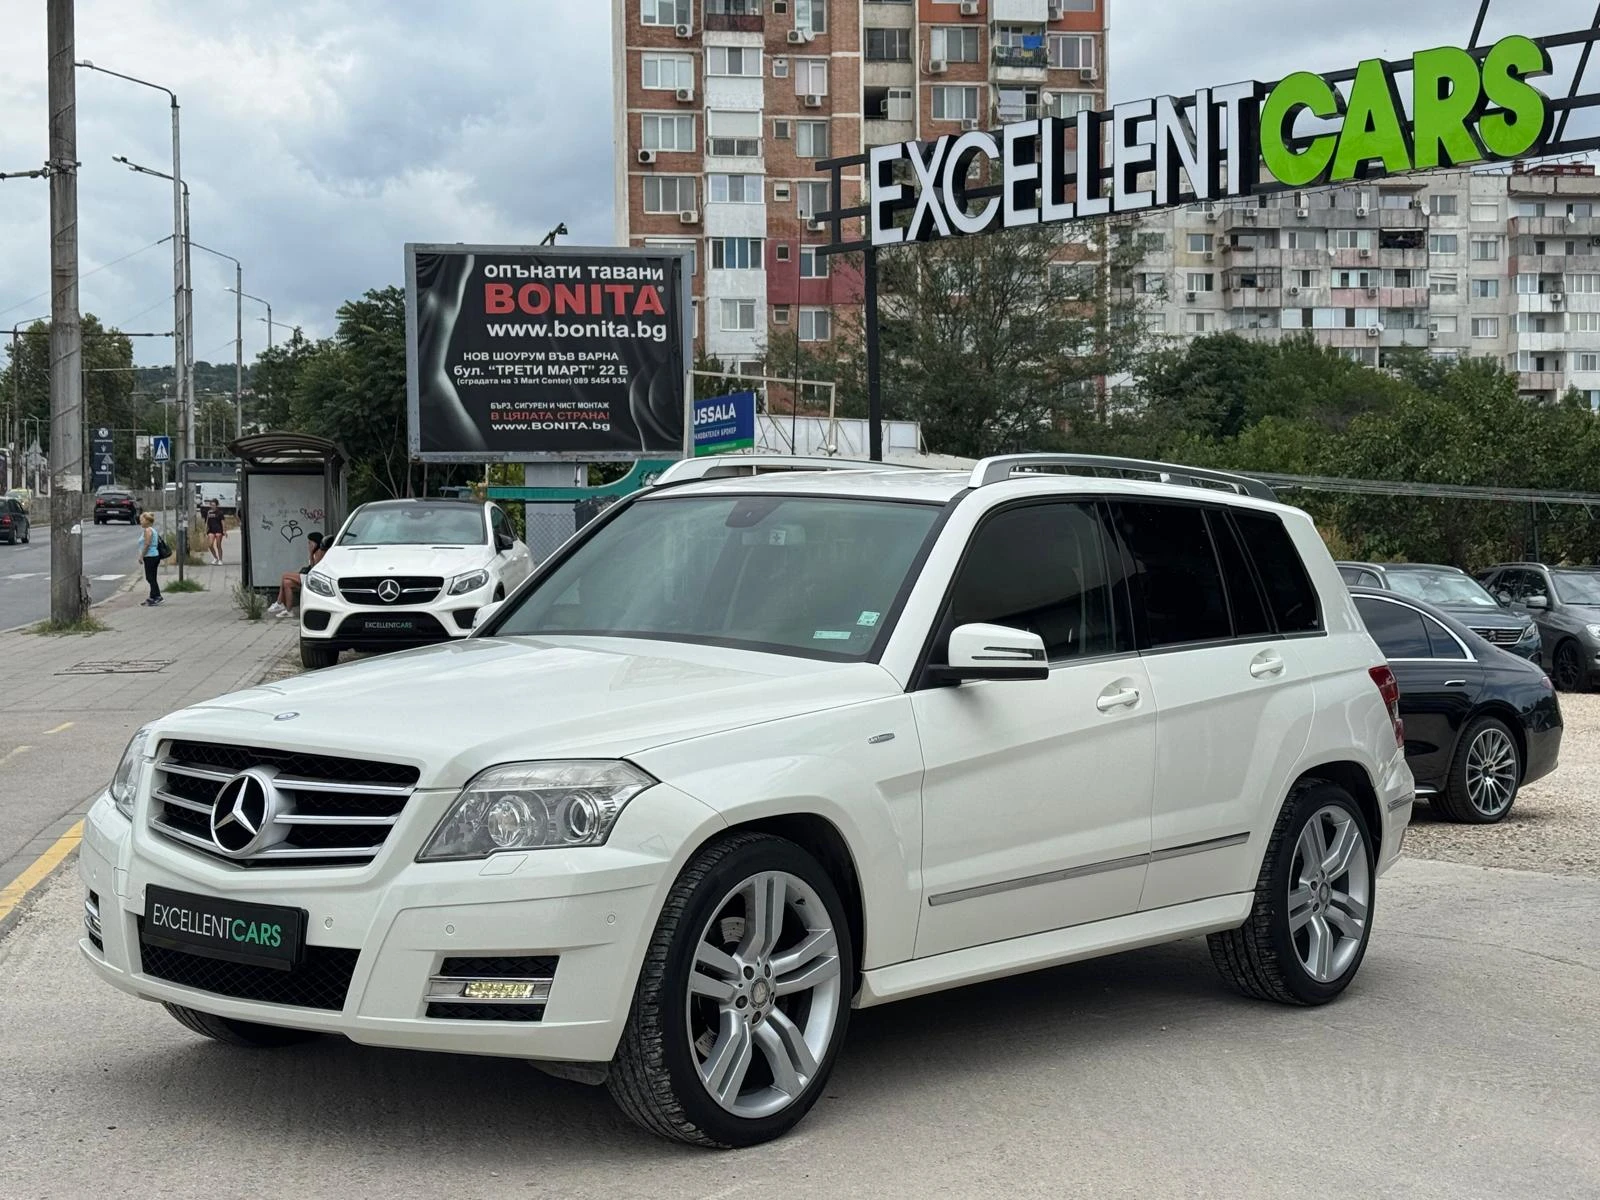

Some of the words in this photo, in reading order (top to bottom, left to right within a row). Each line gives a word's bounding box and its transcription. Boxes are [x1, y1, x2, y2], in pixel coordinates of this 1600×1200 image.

[484, 264, 581, 279] опънати
[588, 265, 664, 281] тавани
[486, 320, 667, 342] www.bonita.bg
[463, 352, 490, 361] НОВ
[492, 352, 546, 361] ШОУРУМ
[548, 352, 575, 361] ВЪВ
[578, 352, 619, 361] ВАРНА
[453, 365, 485, 378] бул.
[599, 365, 616, 376] 22
[619, 365, 629, 376] Б
[513, 377, 519, 385] 3
[520, 377, 539, 385] Mart
[541, 377, 572, 386] Center)
[490, 412, 500, 420] В
[503, 412, 554, 421] ЦЯЛАТА
[557, 411, 610, 420] СТРАНА!
[492, 421, 610, 431] www.BONITA.bg
